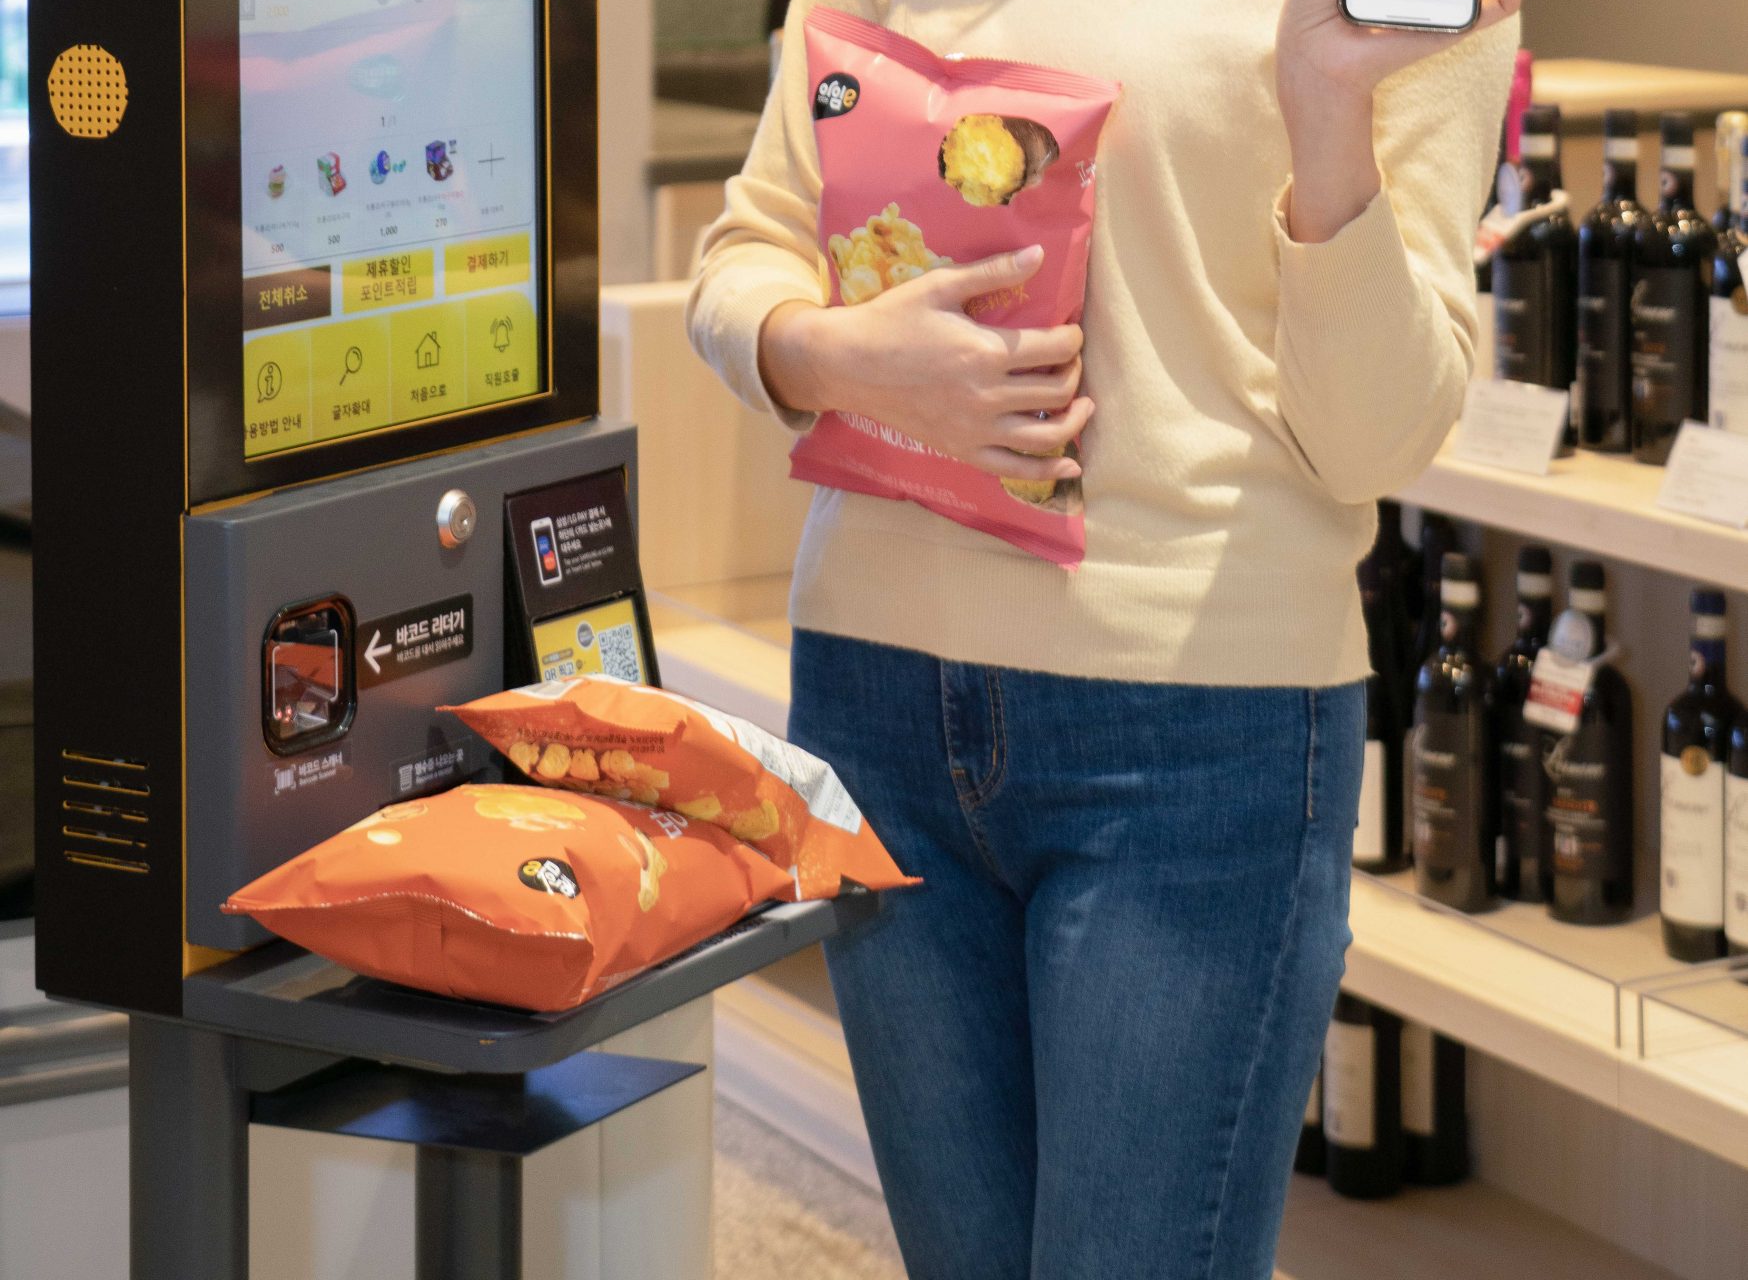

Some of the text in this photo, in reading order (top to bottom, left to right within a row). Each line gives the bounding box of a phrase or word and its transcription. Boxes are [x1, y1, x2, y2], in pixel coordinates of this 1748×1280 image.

[328, 234, 341, 245] 500
[380, 225, 398, 238] 1,000
[366, 254, 412, 278] 제휴할인
[467, 248, 509, 273] 결제하기
[259, 283, 308, 311] 전체취소
[360, 275, 417, 302] 포인트적립
[410, 383, 447, 403] 처음으로
[332, 398, 371, 421] 글자확대
[244, 412, 302, 439] 용방법 안내
[396, 607, 465, 647] 바코드 리더기
[544, 667, 557, 681] QR
[298, 759, 320, 776] 바코드
